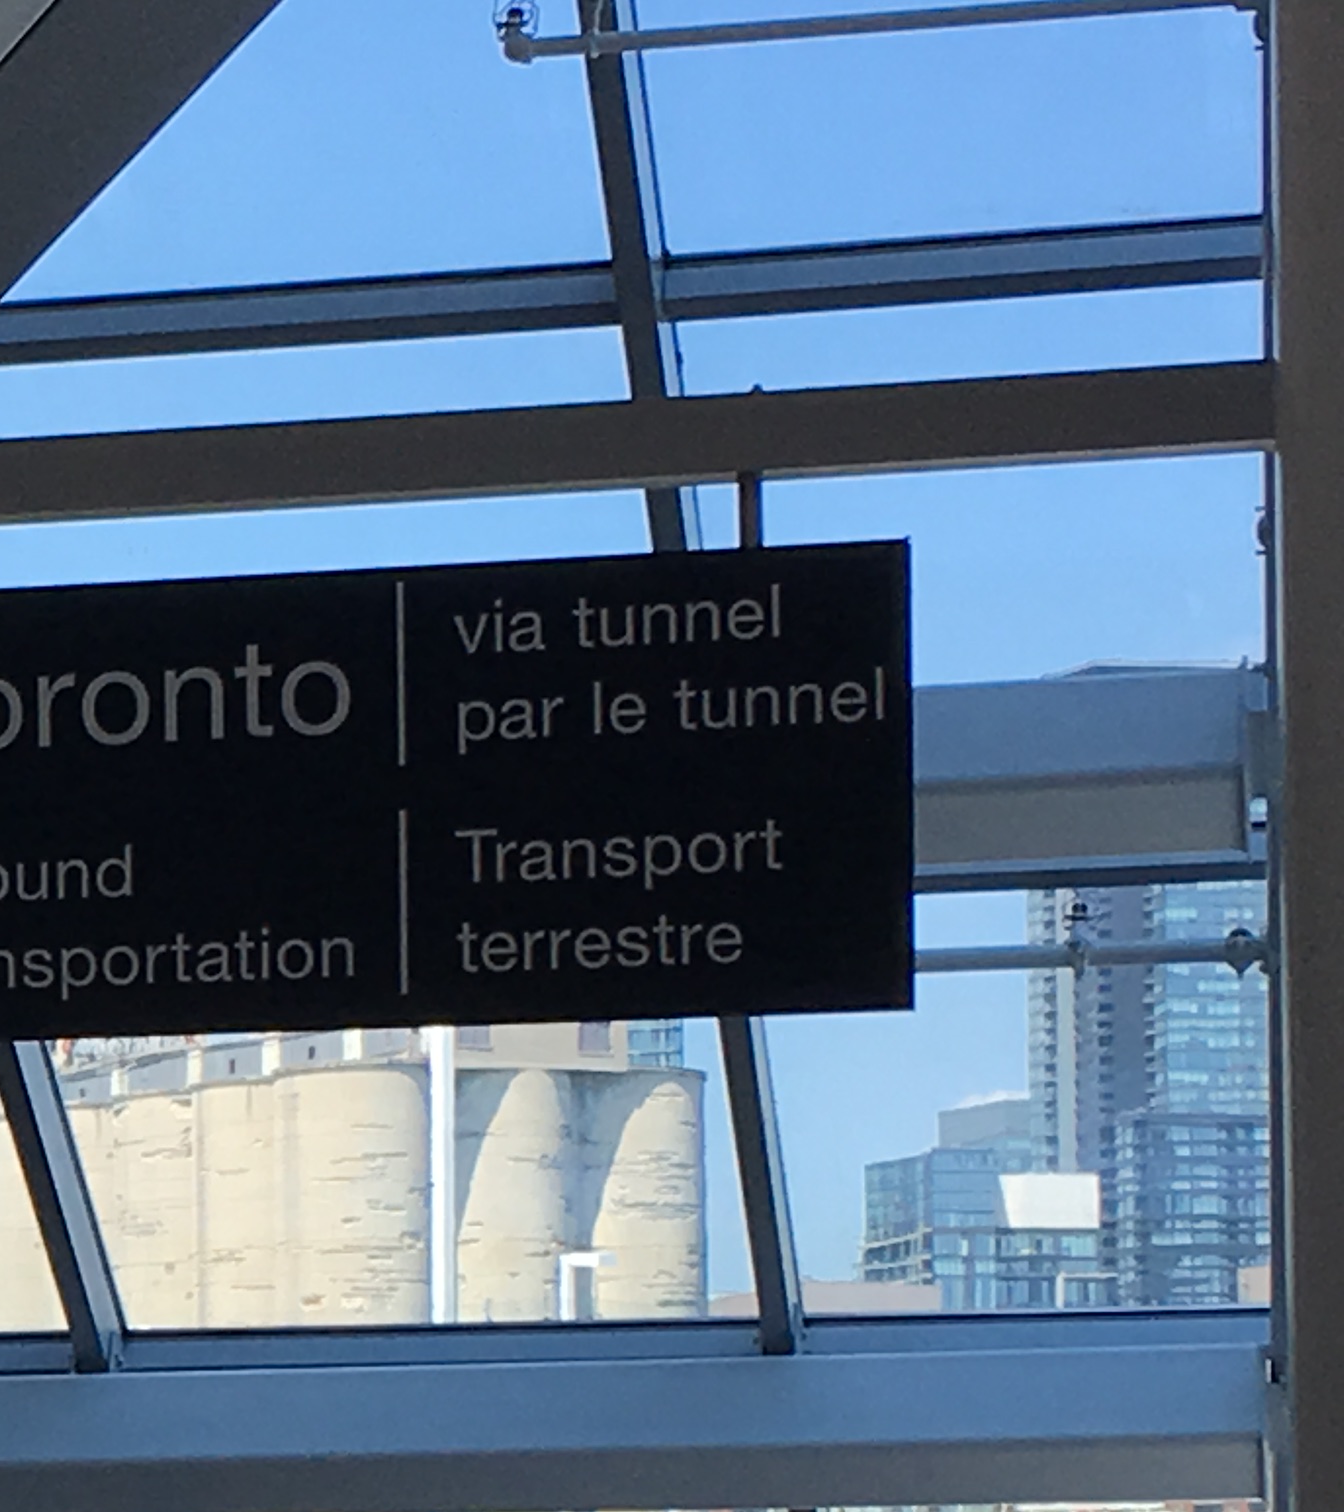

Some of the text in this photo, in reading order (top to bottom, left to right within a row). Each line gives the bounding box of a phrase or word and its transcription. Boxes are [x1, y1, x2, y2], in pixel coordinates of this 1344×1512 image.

[454, 582, 781, 656] via tunnel
[457, 665, 885, 756] par le tunnel
[454, 819, 783, 890] Transport
[456, 913, 743, 973] terrestre
